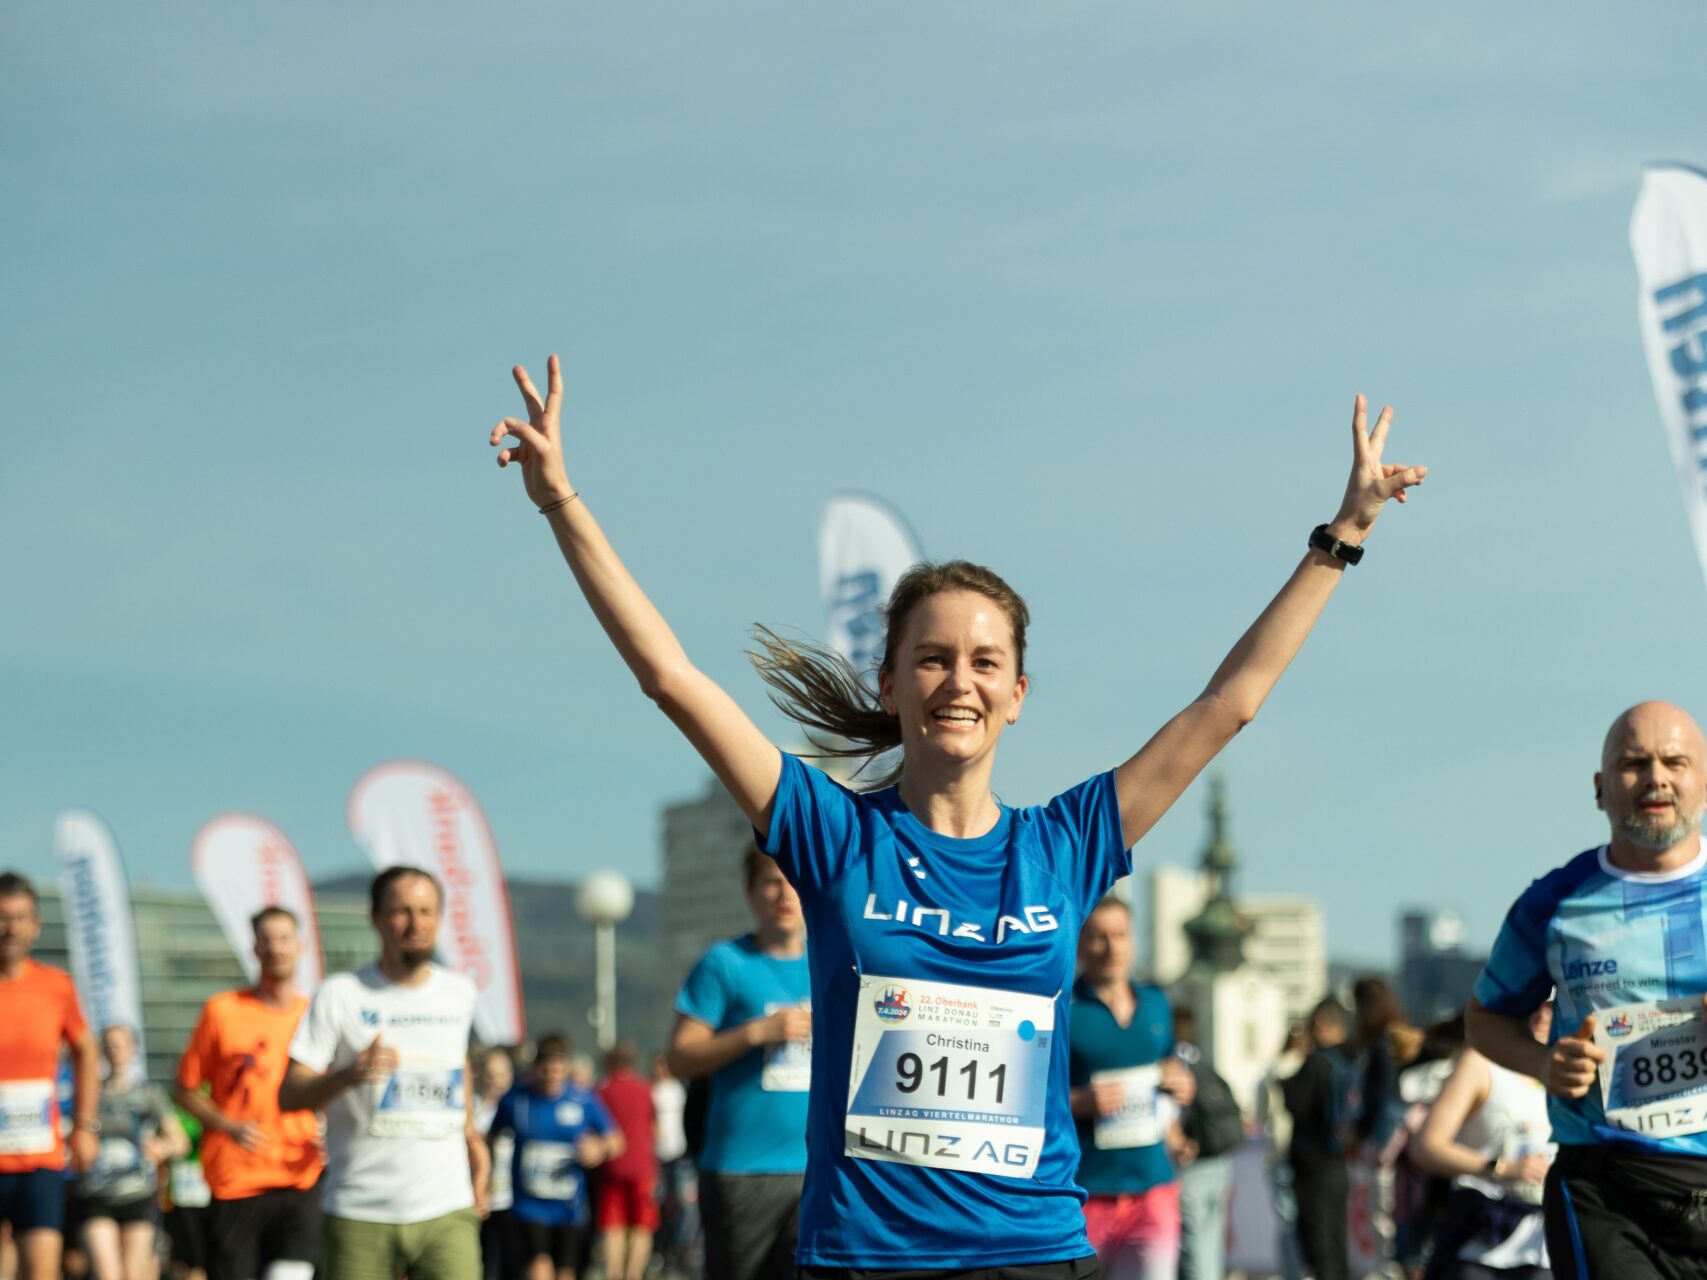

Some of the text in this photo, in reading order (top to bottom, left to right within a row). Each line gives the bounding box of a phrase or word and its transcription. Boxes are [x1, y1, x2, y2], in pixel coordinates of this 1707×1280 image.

[996, 905, 1059, 945] AG
[1623, 979, 1635, 990] to
[935, 996, 978, 1010] Oberbank
[918, 1005, 940, 1014] LINZ
[944, 1008, 978, 1019] DONAU
[917, 1013, 978, 1027] MARATHON
[926, 1033, 990, 1053] Christina
[1649, 1035, 1696, 1049] Miroslav
[895, 1052, 1006, 1105] 9111
[923, 1110, 1020, 1125] VIERTELMARATHON
[971, 1140, 1030, 1167] AG
